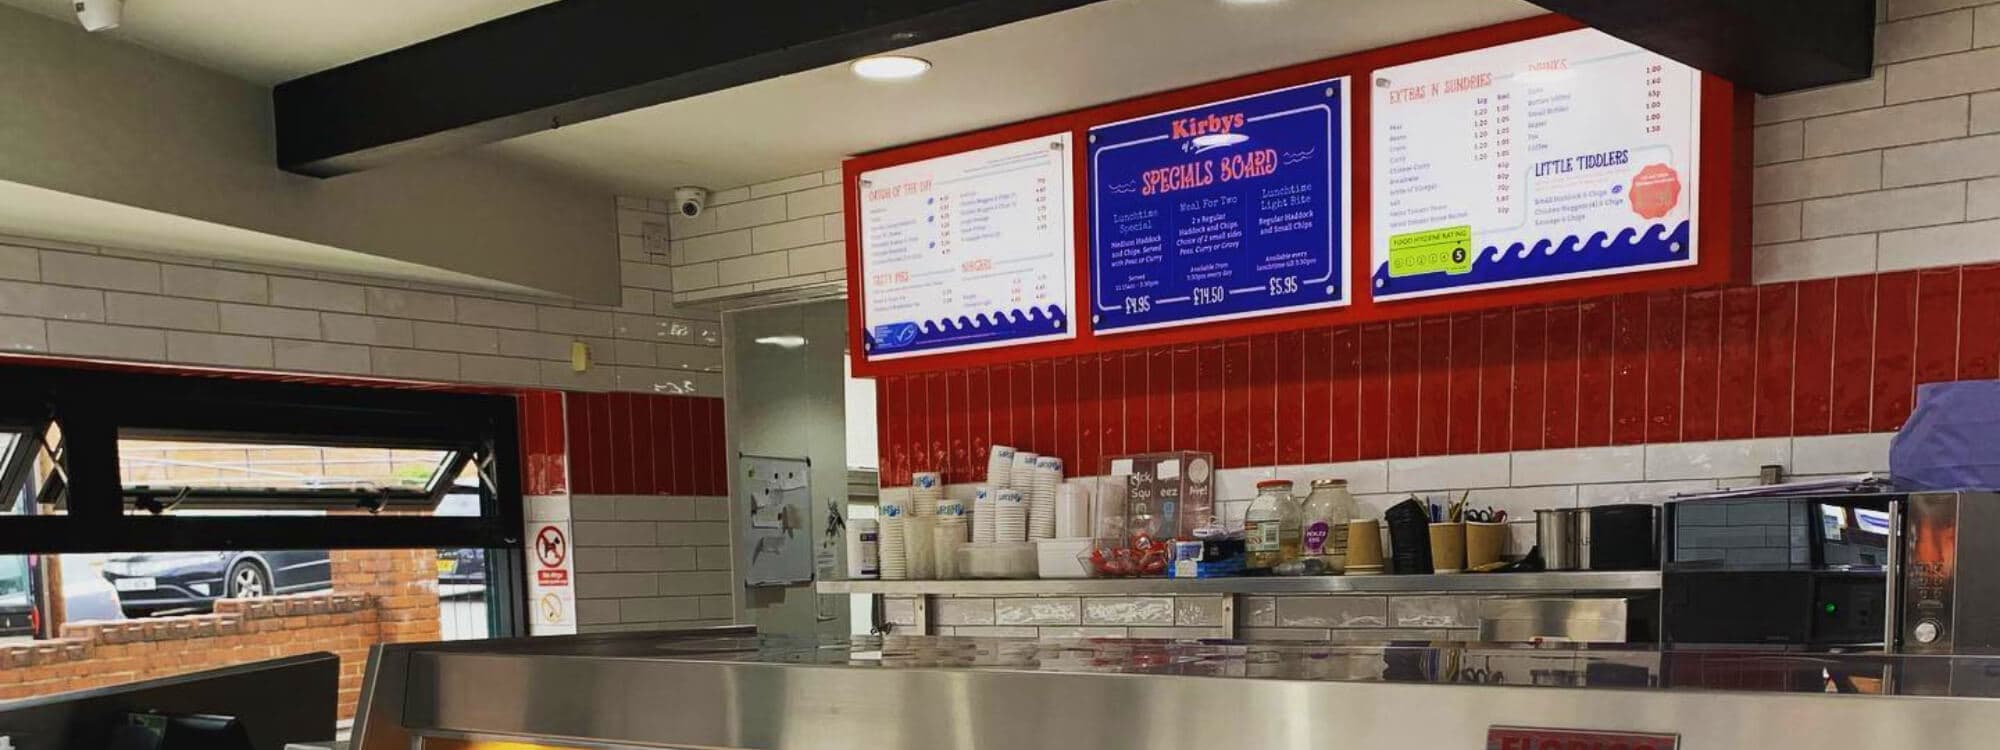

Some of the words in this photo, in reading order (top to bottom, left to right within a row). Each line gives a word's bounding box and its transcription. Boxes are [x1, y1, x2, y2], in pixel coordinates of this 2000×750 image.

[1389, 86, 1426, 104] EXTRAS
[1443, 72, 1493, 93] SUNDRIES
[1172, 112, 1245, 140] Kirbys
[1535, 158, 1574, 177] LITTLE
[1576, 149, 1630, 171] TIDDLERS
[1142, 160, 1214, 196] SPECIALS
[1219, 149, 1279, 182] BOARD
[892, 184, 902, 198] OF
[903, 181, 918, 193] THE
[1262, 183, 1312, 199] Lunchtime
[1179, 202, 1201, 212] Meal
[1202, 198, 1219, 209] For
[1220, 195, 1239, 206] Two
[1260, 198, 1288, 211] Light
[1289, 195, 1312, 207] Bite
[1258, 214, 1284, 227] Regular
[1284, 209, 1314, 222] Haddock
[1119, 220, 1153, 237] Special
[1178, 226, 1205, 237] Haddock
[1206, 223, 1219, 233] and
[1260, 225, 1274, 236] and
[1274, 222, 1292, 233] Small
[1293, 219, 1313, 232] Chips
[1111, 239, 1135, 249] Medium
[1136, 234, 1162, 246] Haddock
[1176, 237, 1196, 247] Choice
[1195, 244, 1212, 254] Curry
[1221, 240, 1241, 250] Gravy
[1393, 237, 1414, 248] FOOD
[1441, 229, 1467, 240] RATING
[1142, 244, 1162, 254] Served
[1145, 254, 1163, 264] Curry
[1268, 275, 1299, 297] £5.95
[1192, 285, 1225, 306] £14.50
[1125, 294, 1151, 315] £4.95
